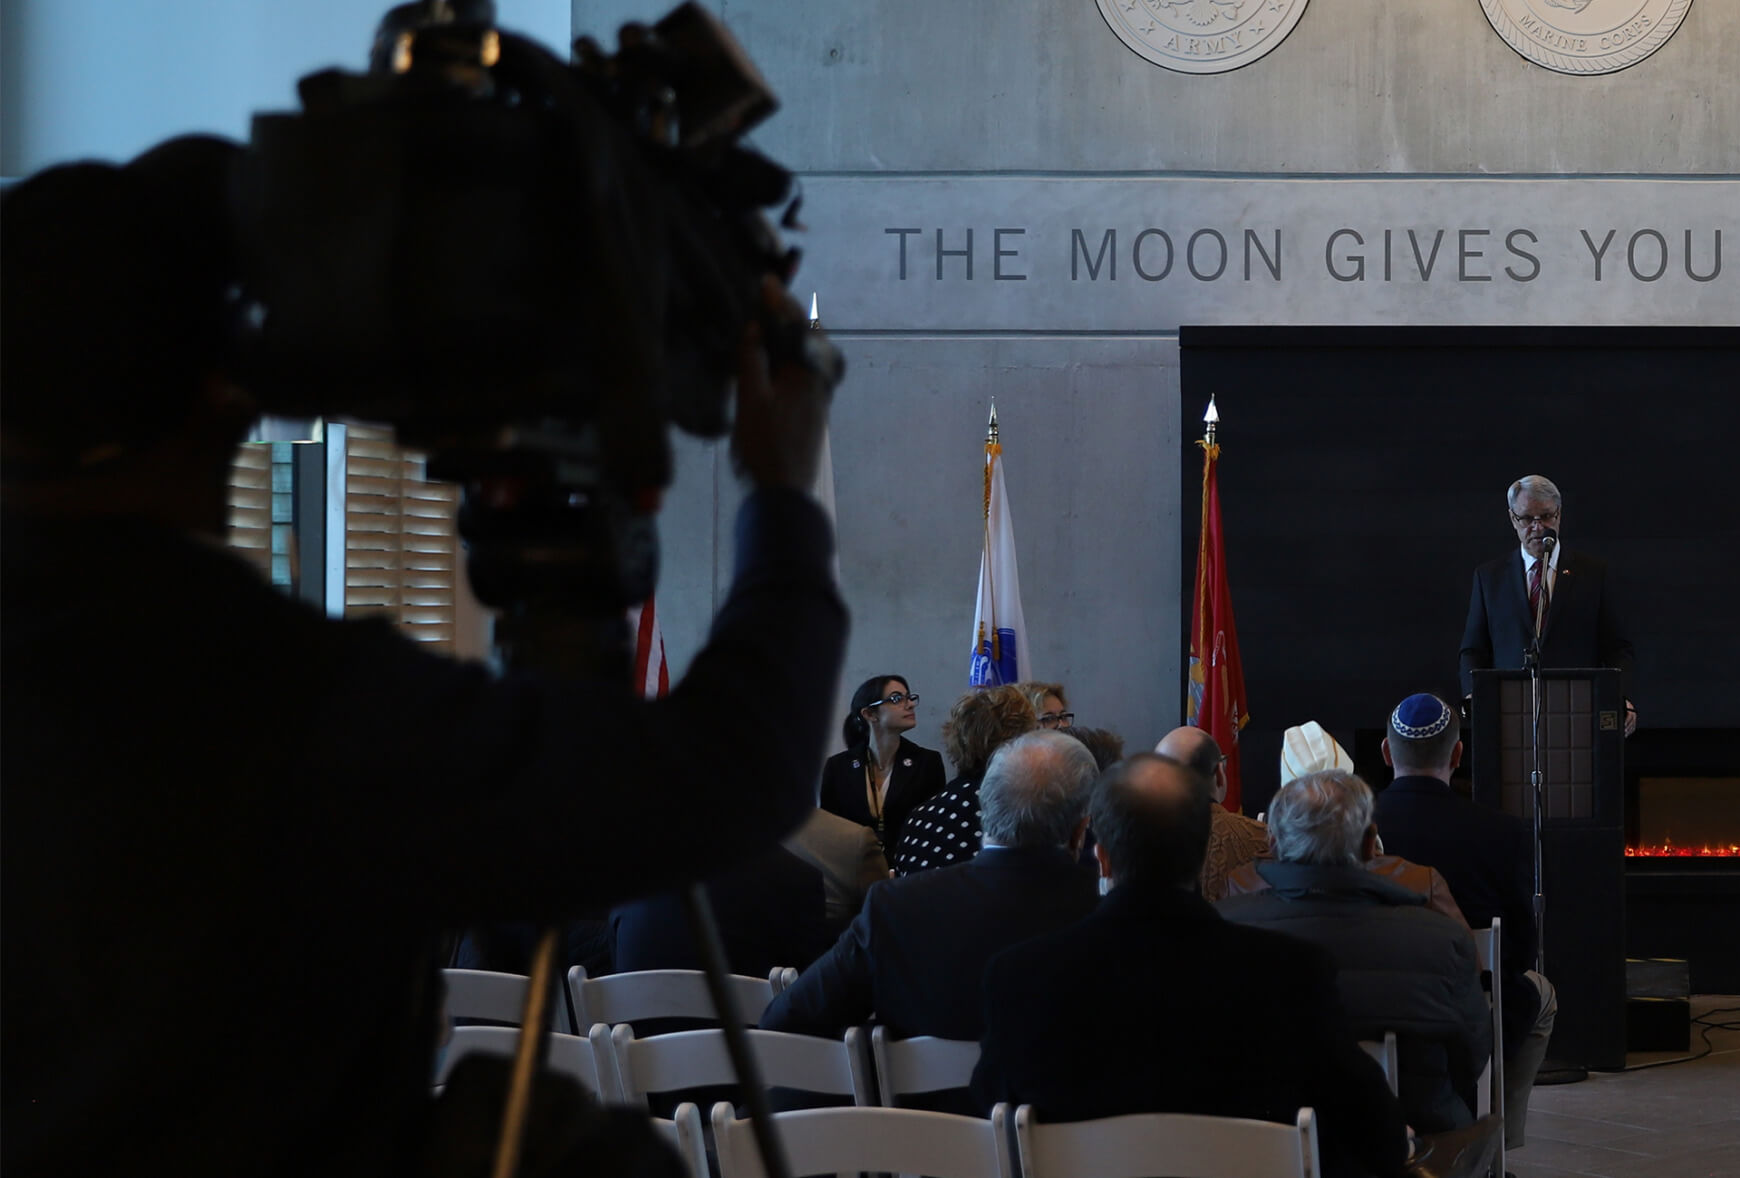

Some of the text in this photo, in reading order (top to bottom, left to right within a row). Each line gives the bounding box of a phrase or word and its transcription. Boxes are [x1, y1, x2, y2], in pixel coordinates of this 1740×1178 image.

[1164, 30, 1243, 56] ARMY
[1519, 14, 1653, 52] MARINE CORPS
[884, 227, 1028, 282] THE
[1070, 227, 1283, 283] MOON
[1325, 227, 1542, 283] GIVES
[1579, 228, 1723, 283] YOU
